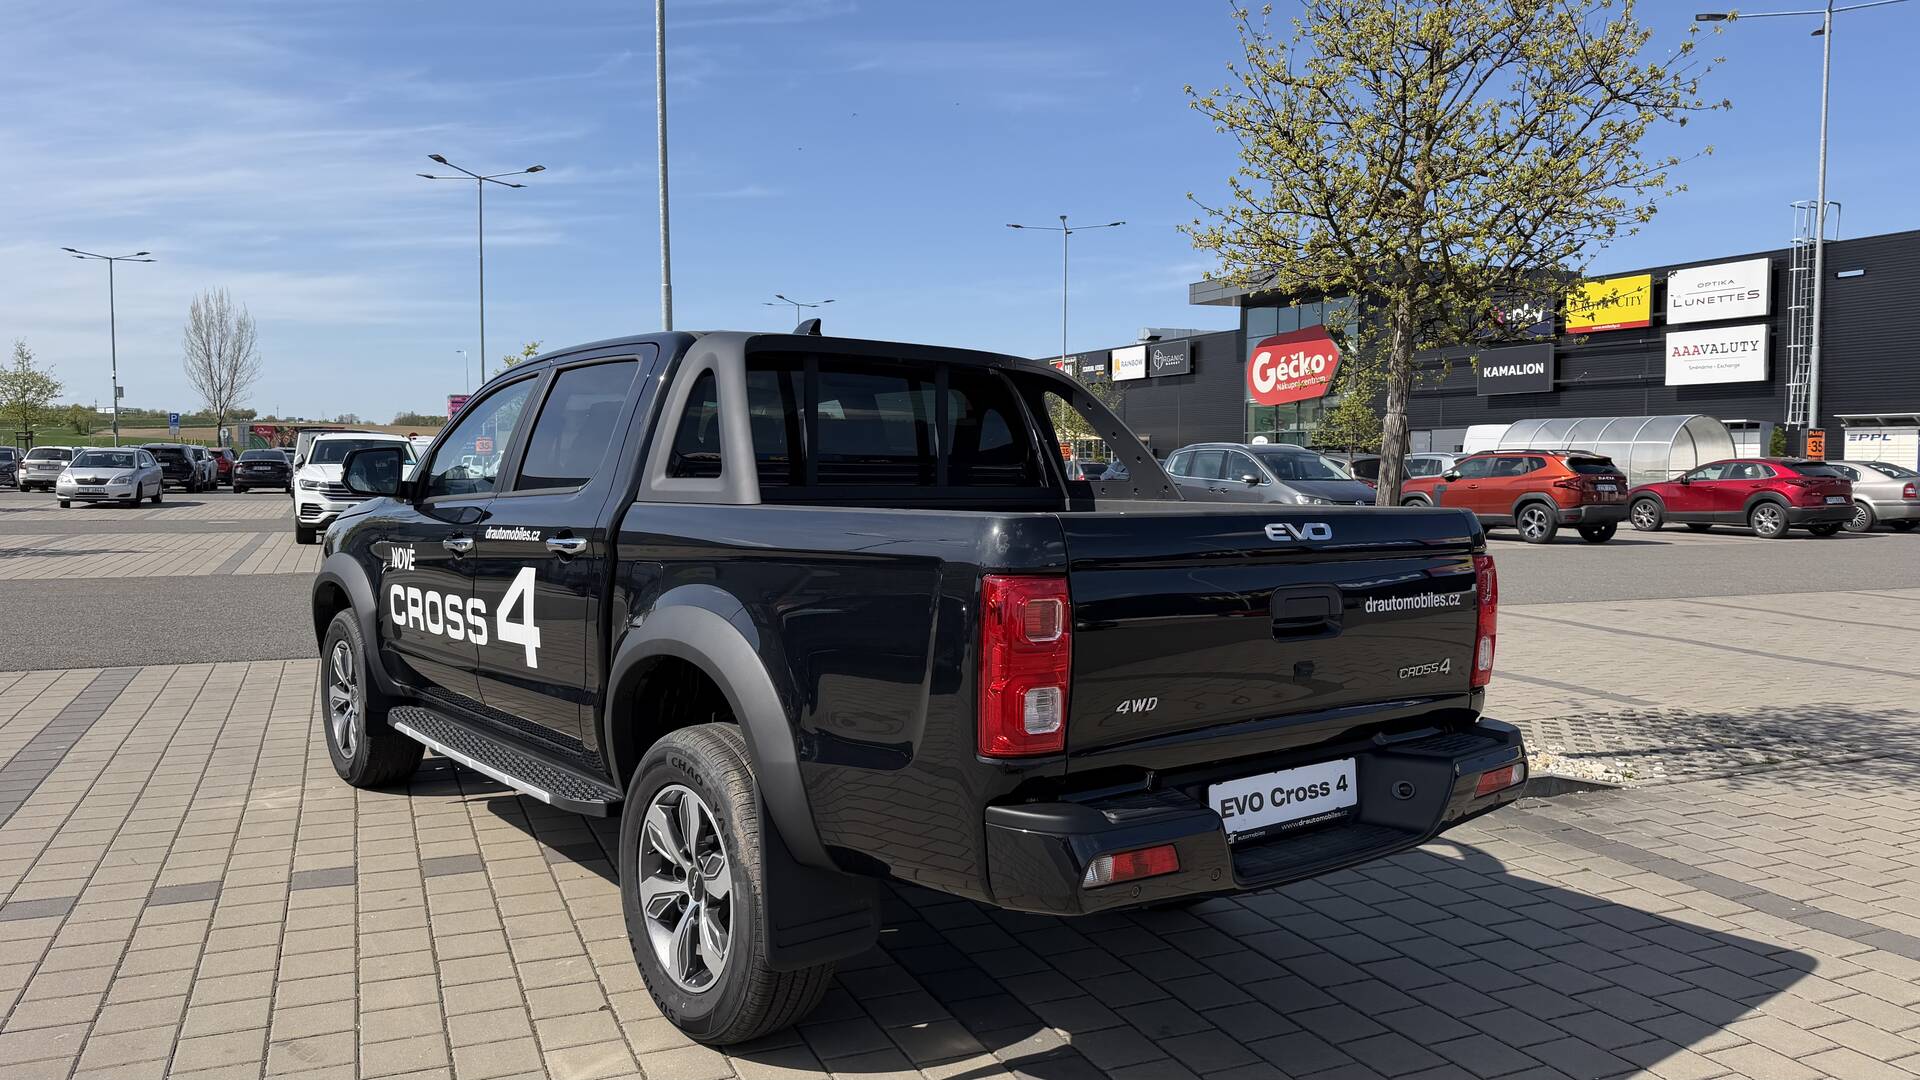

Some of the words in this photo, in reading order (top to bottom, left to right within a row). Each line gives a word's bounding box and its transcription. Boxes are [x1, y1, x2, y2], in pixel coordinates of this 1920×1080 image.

[1697, 279, 1735, 288] OPTIKA
[1616, 296, 1643, 308] CITY
[1673, 290, 1760, 308] LUNETTES
[1672, 340, 1760, 357] AAAVALUTY
[1121, 359, 1143, 368] RAINBOW
[1252, 351, 1325, 394] Géčko
[1483, 362, 1545, 378] KAMALION
[485, 526, 541, 542] drautomobiles.cz
[1265, 522, 1333, 542] EVO
[391, 544, 415, 571] NOVÉ
[1365, 592, 1461, 615] drautomobiles.cz
[390, 583, 488, 646] CROSS
[496, 566, 541, 669] 4
[1115, 696, 1159, 715] 4WD
[671, 756, 703, 787] CHAO
[1220, 792, 1264, 819] EVO
[1270, 781, 1330, 808] Cross
[1336, 774, 1348, 791] 4
